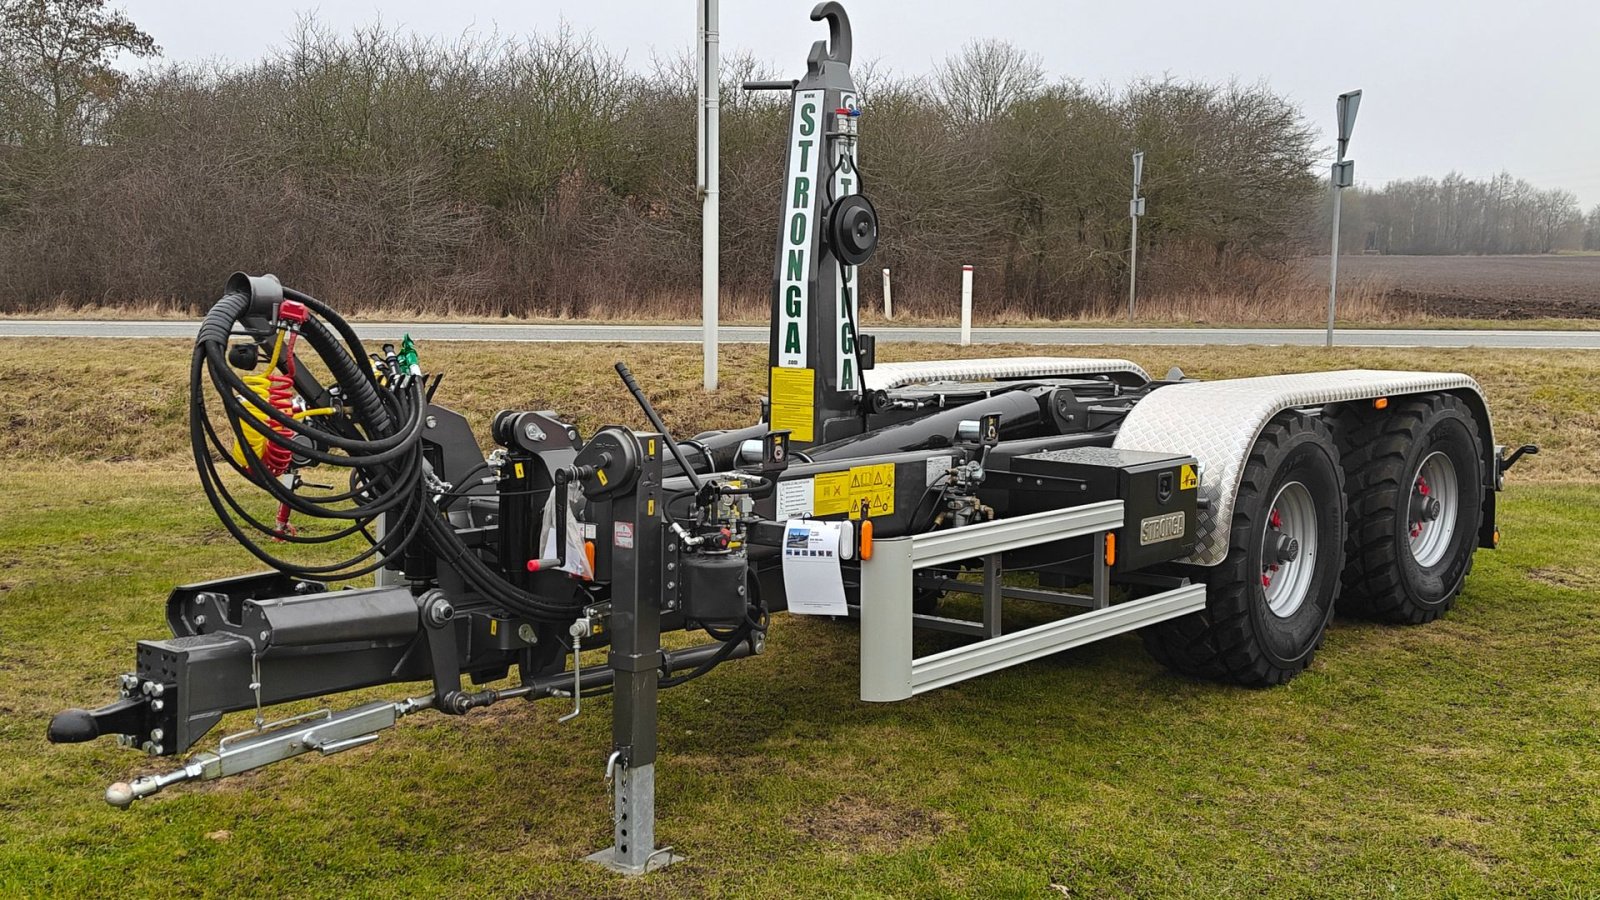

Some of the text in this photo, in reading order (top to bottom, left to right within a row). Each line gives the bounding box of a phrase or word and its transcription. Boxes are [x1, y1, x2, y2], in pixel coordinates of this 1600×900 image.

[784, 103, 816, 354] STRONGA
[841, 145, 854, 390] STNGA
[1142, 515, 1184, 542] STRONGA
